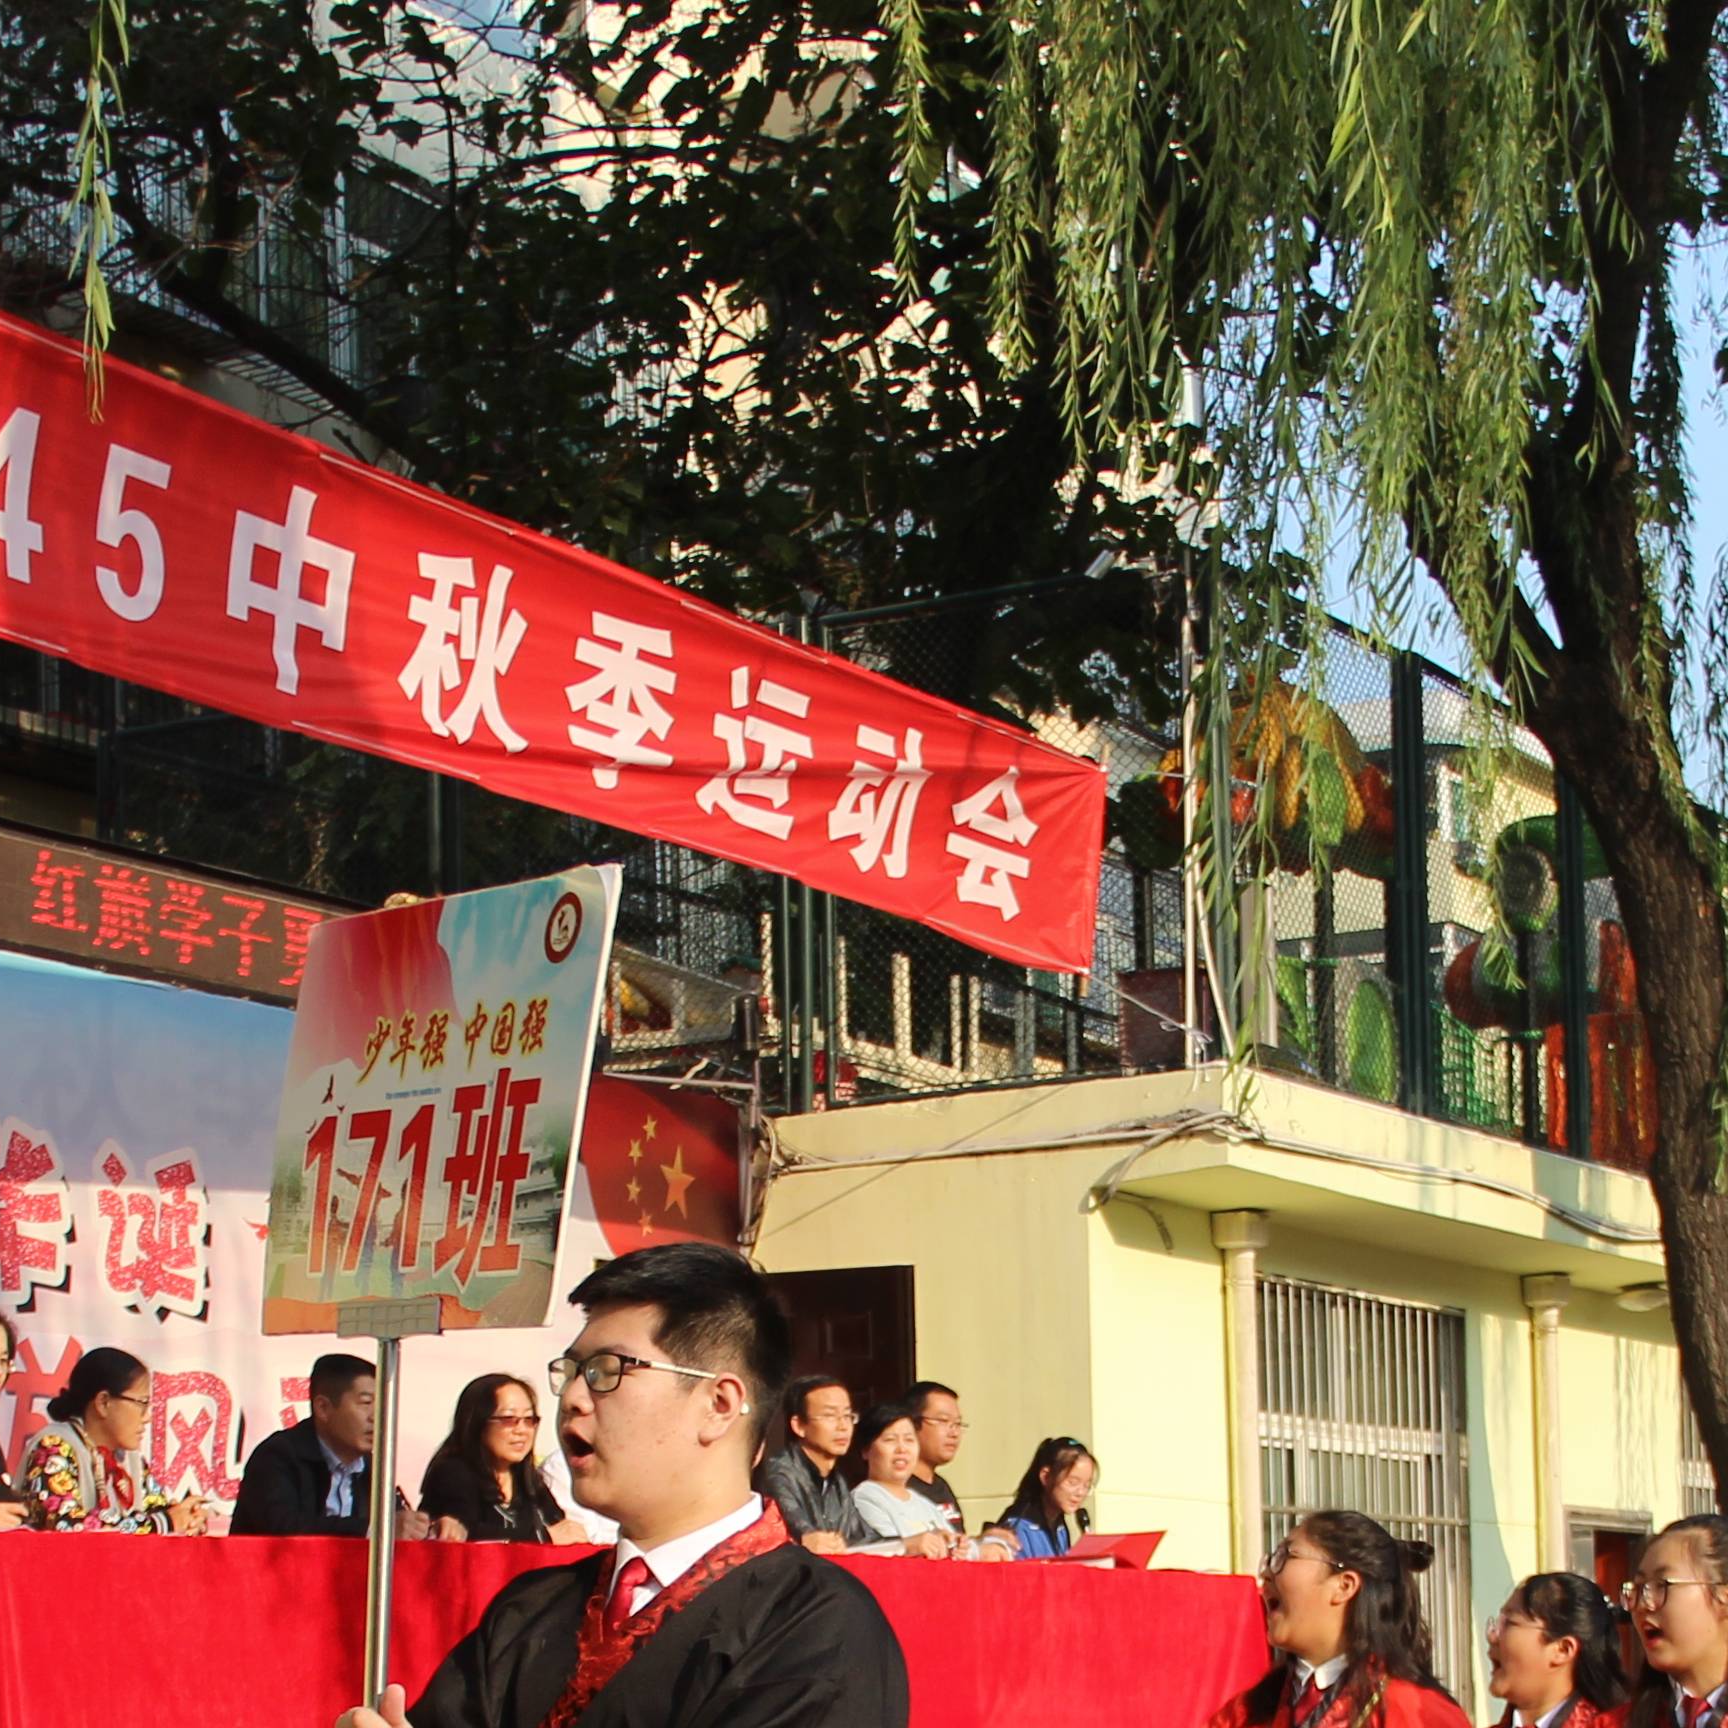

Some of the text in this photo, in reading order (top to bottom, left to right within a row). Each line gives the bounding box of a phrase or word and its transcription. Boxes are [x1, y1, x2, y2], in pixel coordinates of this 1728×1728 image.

[357, 998, 550, 1087] 少年强 中国强
[304, 1067, 542, 1293] 171班
